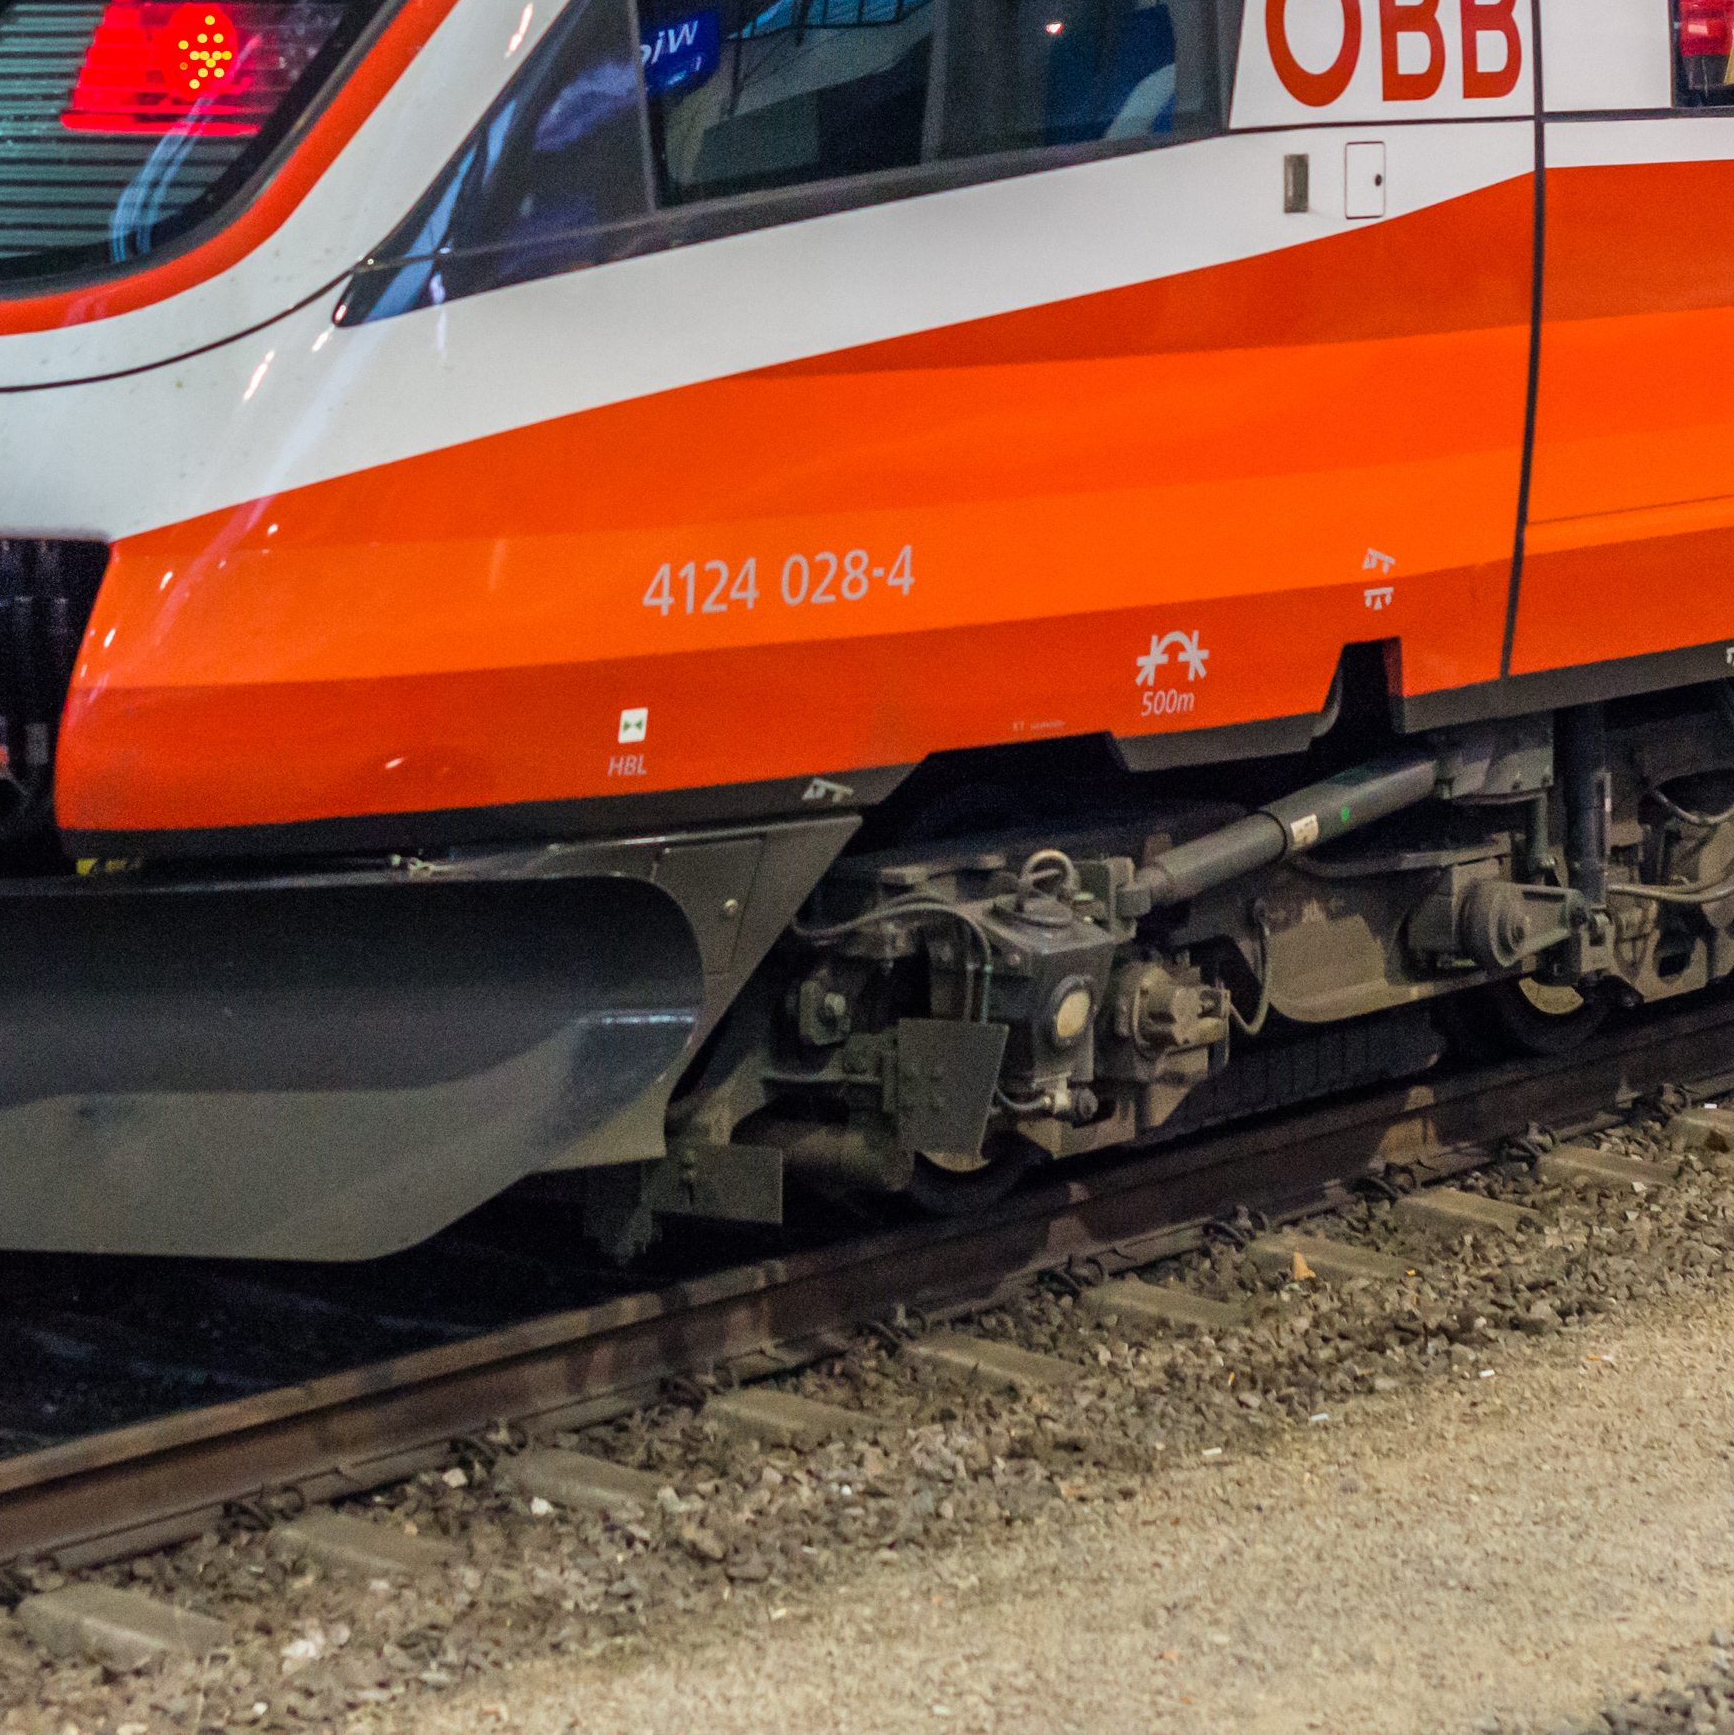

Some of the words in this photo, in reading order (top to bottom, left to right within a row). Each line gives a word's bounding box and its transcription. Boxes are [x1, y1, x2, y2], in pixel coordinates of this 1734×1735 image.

[643, 557, 761, 617] 4124
[780, 543, 915, 607] 028-4
[1140, 688, 1196, 717] 500m
[607, 754, 647, 777] HBL
